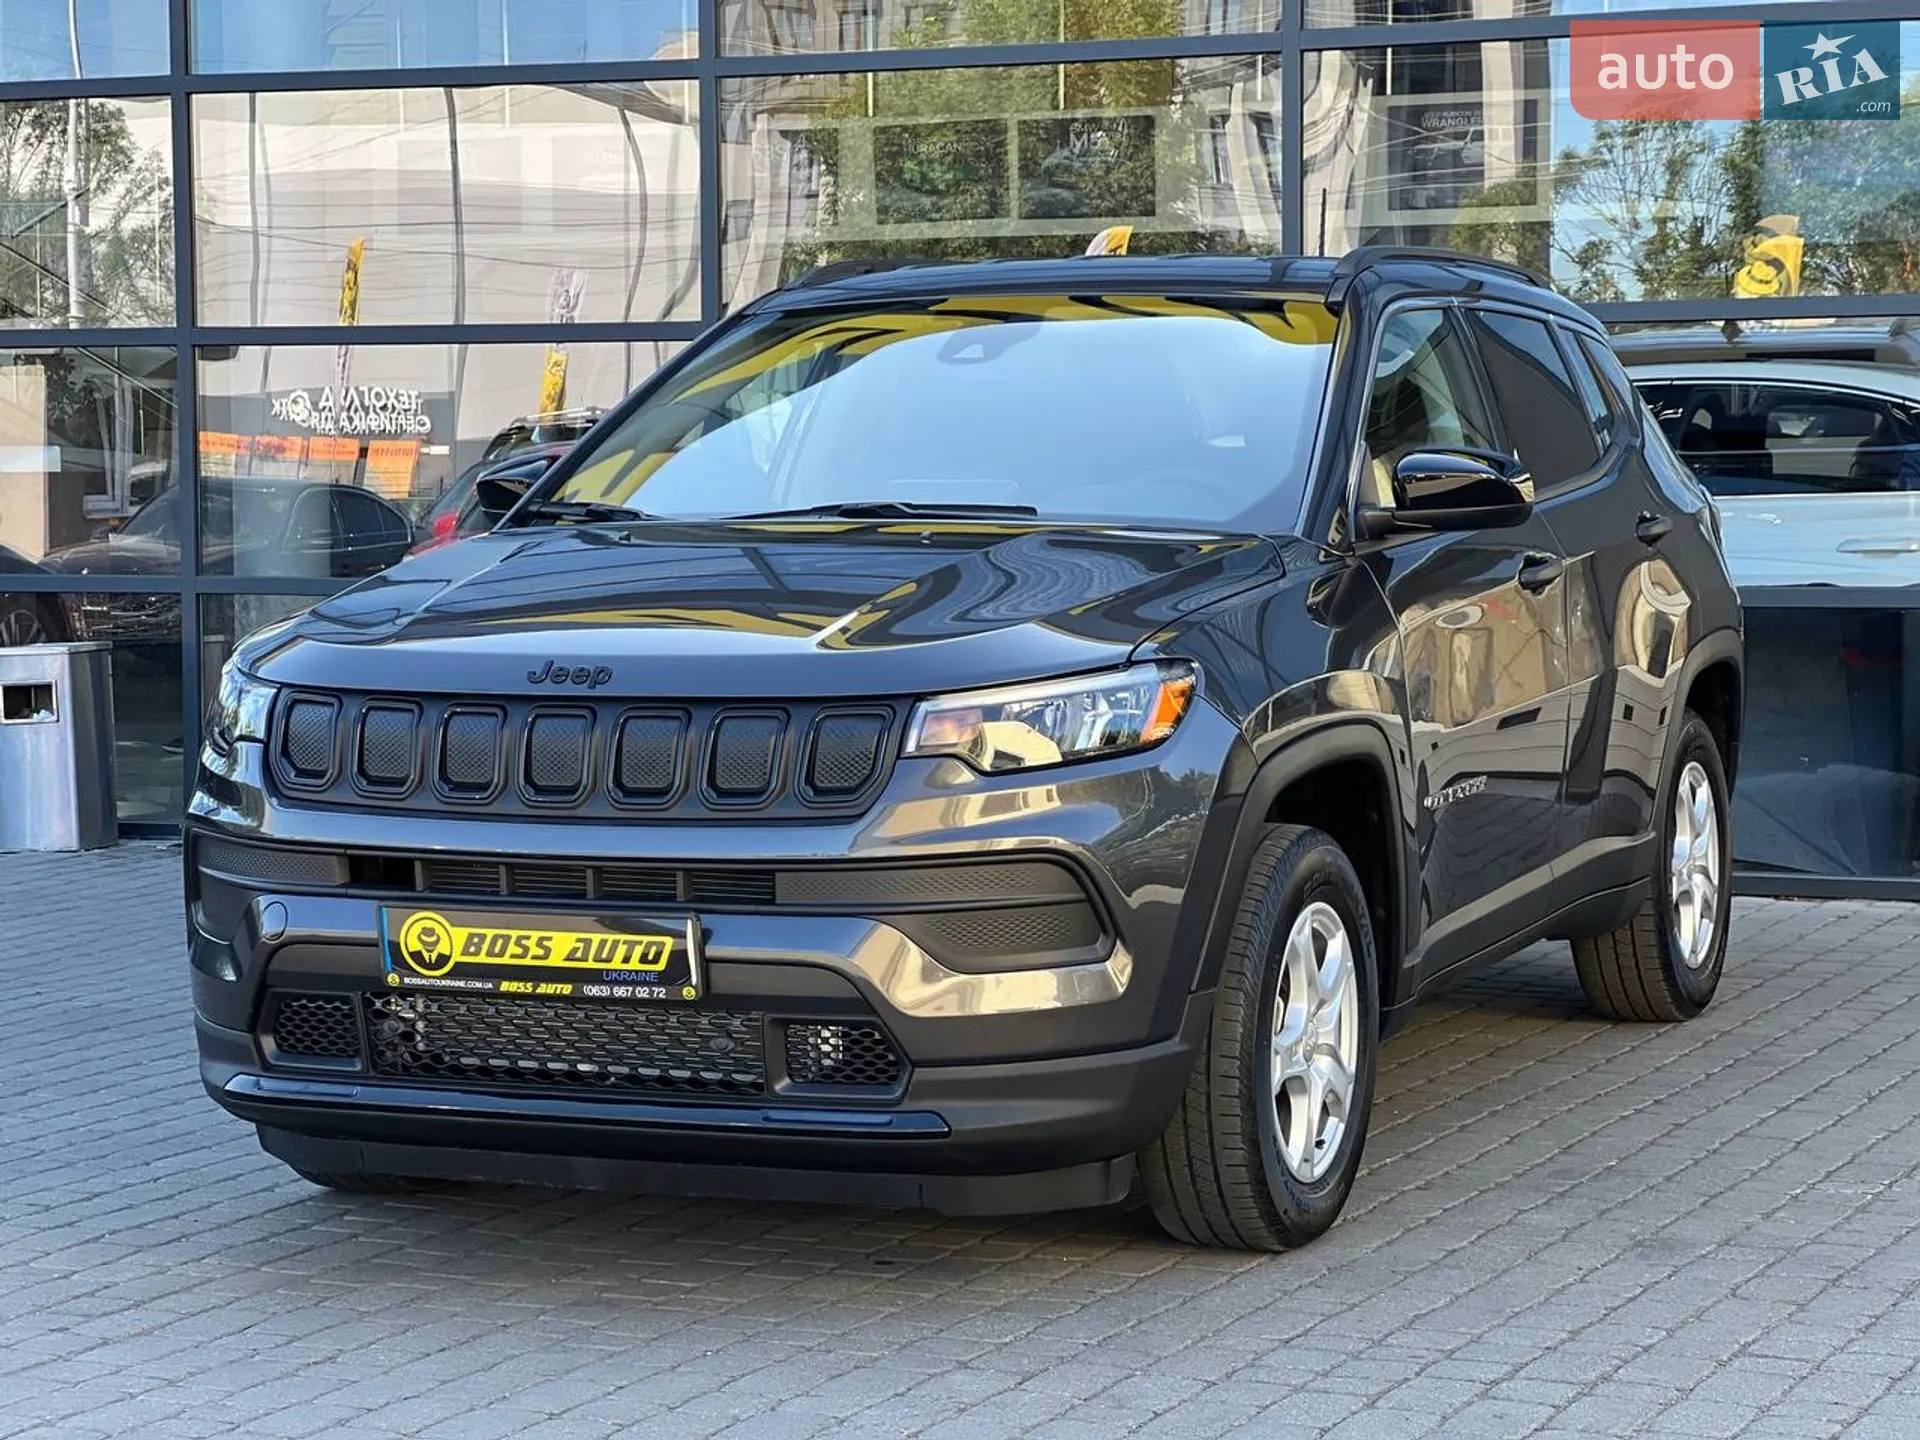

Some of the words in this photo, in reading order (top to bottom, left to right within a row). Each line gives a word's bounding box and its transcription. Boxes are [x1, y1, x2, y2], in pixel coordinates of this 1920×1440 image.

[527, 660, 613, 689] Jeep
[460, 932, 553, 961] BOSS
[563, 937, 667, 965] AUTO
[602, 970, 659, 983] UKRAINE
[500, 981, 533, 993] BOSS
[536, 983, 573, 995] AUTO
[583, 985, 610, 997] (063)
[613, 986, 633, 998] 667
[635, 987, 650, 998] 02
[653, 987, 666, 998] 72
